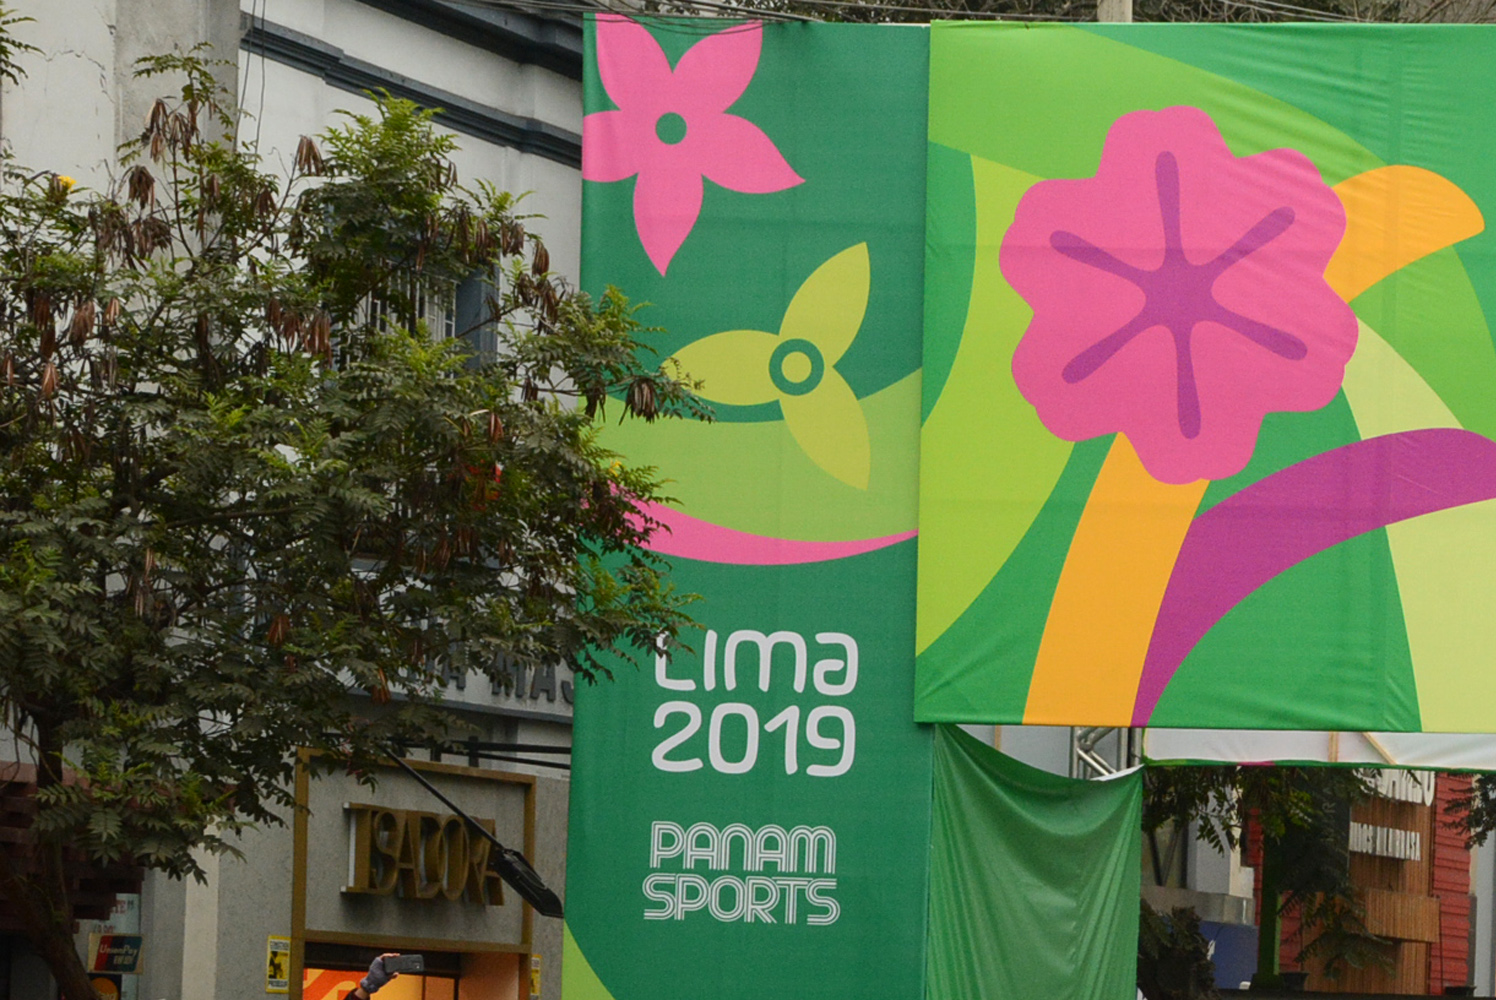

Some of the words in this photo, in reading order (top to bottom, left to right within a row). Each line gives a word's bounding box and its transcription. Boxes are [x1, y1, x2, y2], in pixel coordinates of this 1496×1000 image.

[651, 700, 856, 778] 2019
[649, 820, 837, 874] PANAM
[642, 873, 841, 926] SPORTS
